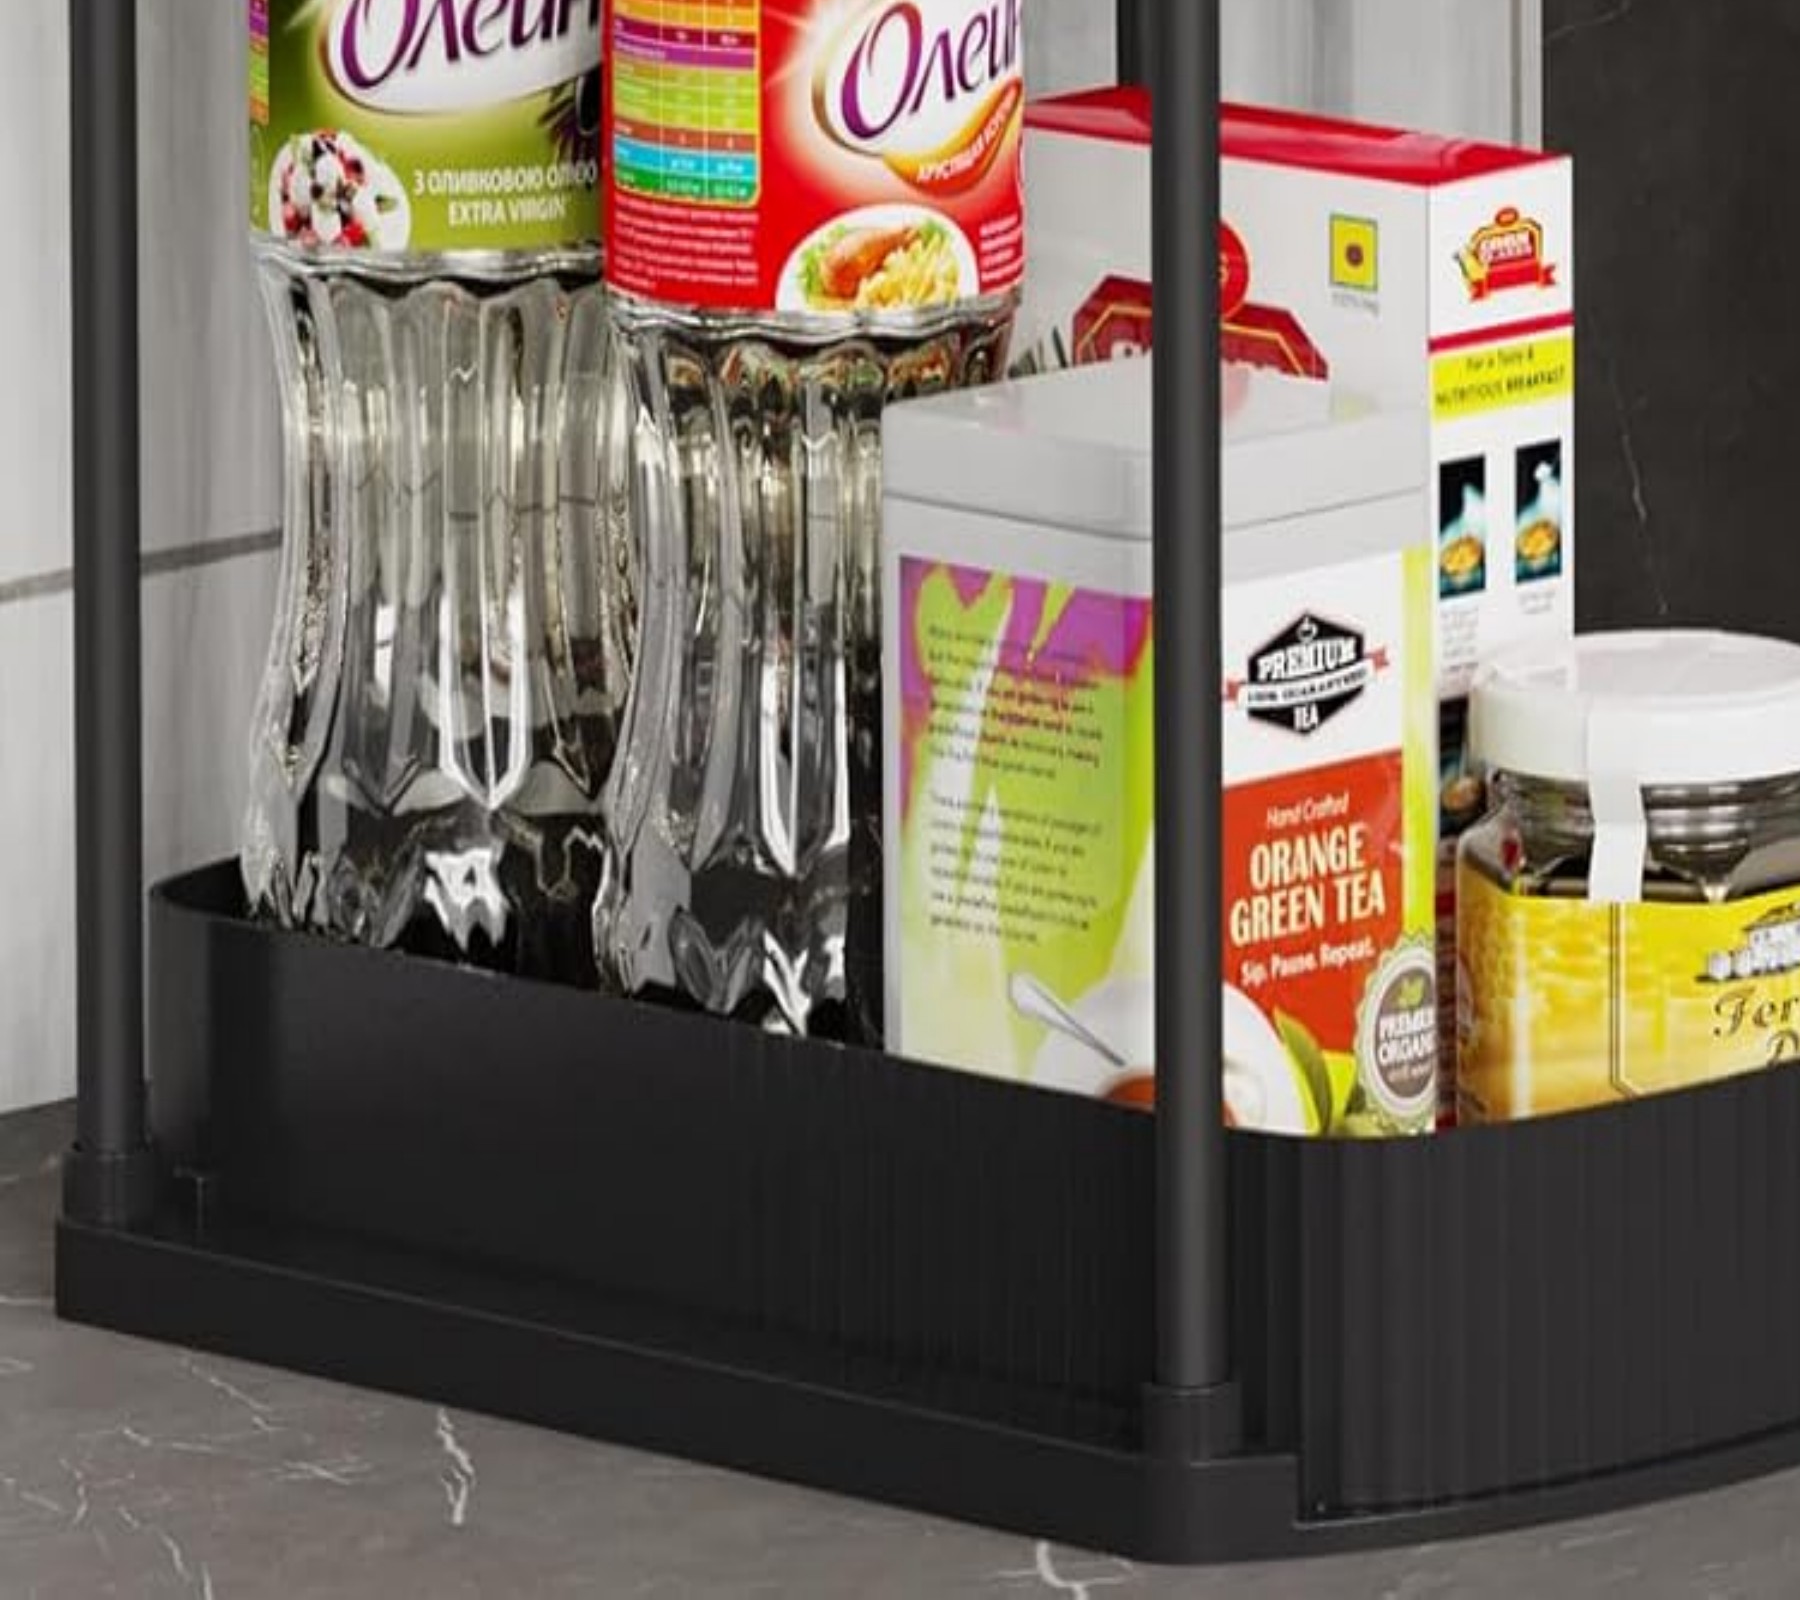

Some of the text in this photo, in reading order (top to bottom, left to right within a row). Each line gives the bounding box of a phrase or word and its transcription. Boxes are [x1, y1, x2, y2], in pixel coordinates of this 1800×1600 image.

[448, 196, 566, 226] EXTRA VIRGIN
[1506, 363, 1566, 392] BREAKFAST
[1256, 637, 1358, 681] PREMIUM
[1293, 703, 1319, 730] TEA
[1266, 792, 1350, 828] Hand Crafted
[1249, 822, 1366, 892] ORANGE
[1229, 867, 1386, 947] GREEN TEA
[1319, 934, 1376, 971] Repeat.
